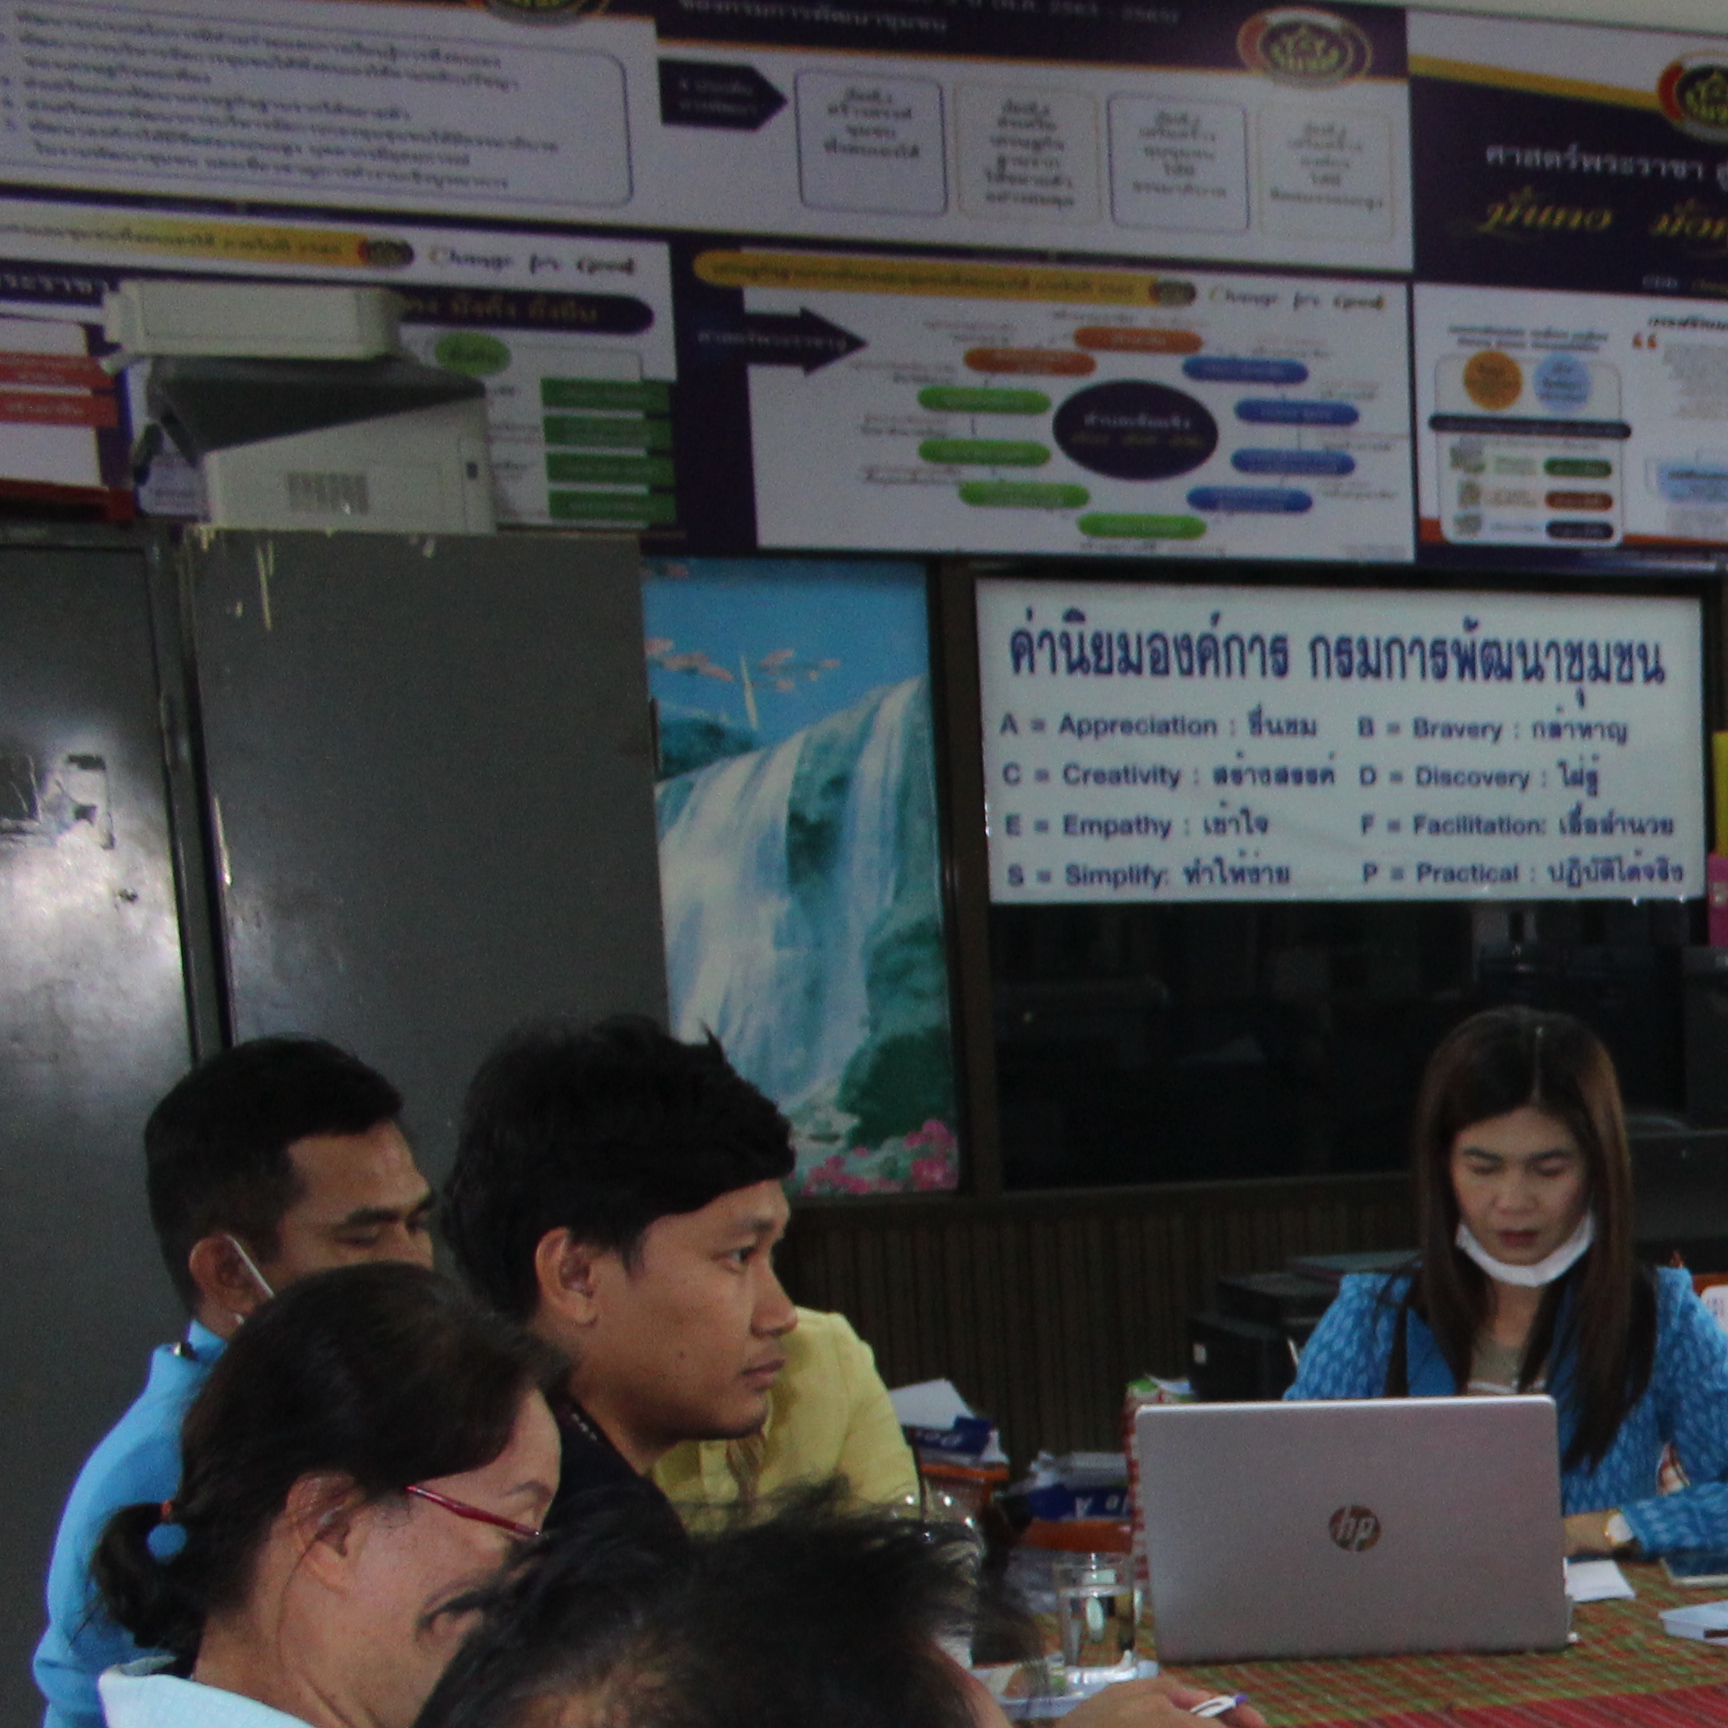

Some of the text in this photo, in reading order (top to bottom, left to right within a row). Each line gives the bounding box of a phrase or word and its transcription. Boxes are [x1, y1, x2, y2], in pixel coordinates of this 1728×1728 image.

[1485, 142, 1703, 181] ศาสตร์พระราชา
[1010, 606, 1666, 709] ค่านิยมองค์การ กรมการพัฒนาชุมชน
[1000, 712, 1018, 736] A
[1058, 712, 1217, 740] Appreciation
[1248, 701, 1317, 737] ชื่นชม
[1358, 716, 1375, 737] B
[1412, 716, 1503, 744] Bravery
[1532, 704, 1629, 745] กล้าหาญ
[1002, 761, 1022, 786] C
[1062, 761, 1182, 791] Creativity
[1212, 750, 1336, 786] สร้างสรรค์
[1359, 764, 1378, 787] D
[1415, 764, 1531, 792] Discovery
[1005, 813, 1022, 836] E
[1062, 813, 1173, 841] Empathy
[1203, 799, 1270, 836] เข้าใจ
[1361, 813, 1376, 836] F
[1007, 863, 1025, 888] S
[1362, 861, 1379, 884] P
[1416, 861, 1519, 884] Practical
[1336, 1504, 1376, 1553] hp
